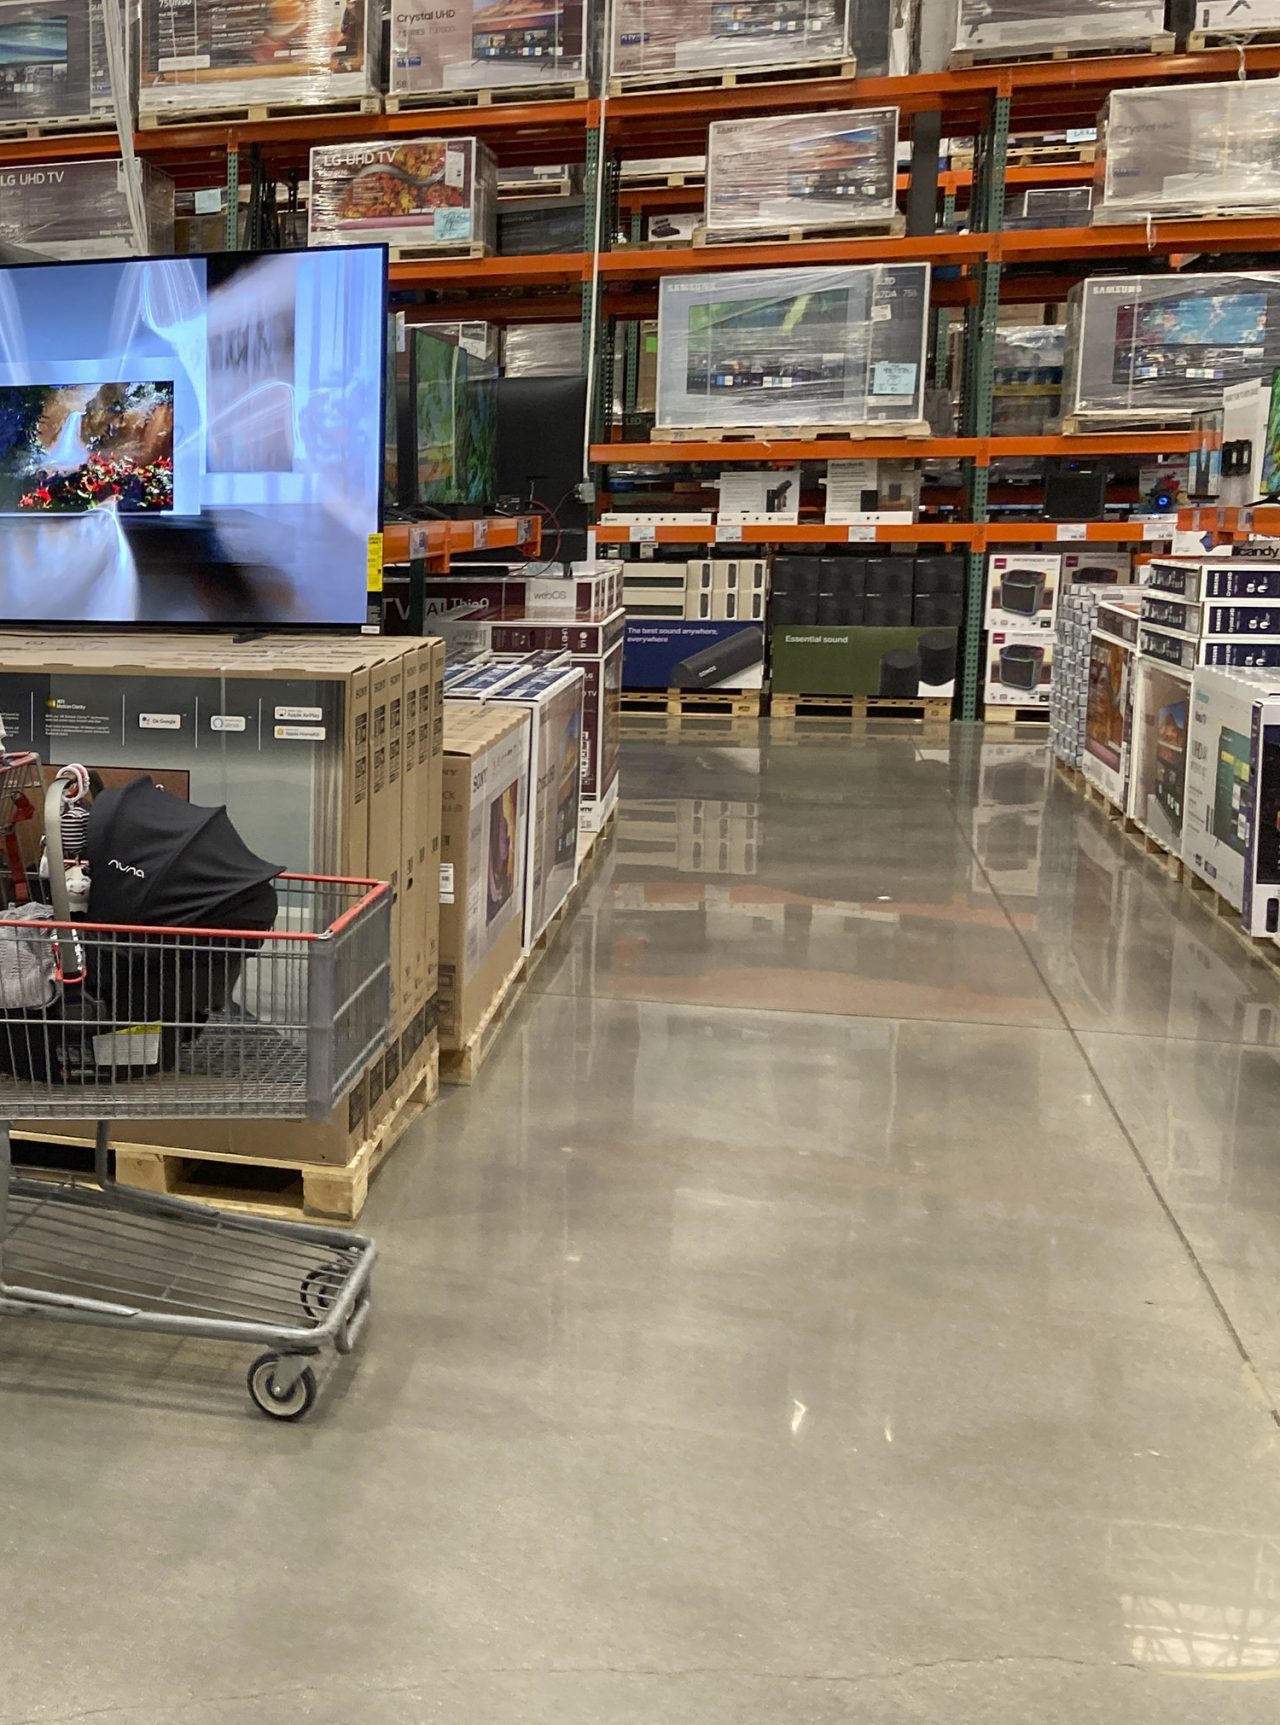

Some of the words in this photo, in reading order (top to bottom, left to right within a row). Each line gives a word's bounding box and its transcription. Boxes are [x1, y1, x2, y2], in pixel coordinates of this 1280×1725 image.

[397, 11, 434, 24] Crystal
[435, 9, 456, 19] UHD
[324, 154, 343, 167] LG
[346, 151, 375, 166] UHD
[377, 147, 401, 163] TV
[0, 174, 16, 187] LG
[19, 172, 46, 186] UHD
[47, 170, 65, 183] TV
[1092, 285, 1143, 295] SAMSUNG
[533, 590, 567, 600] webOS
[383, 598, 411, 621] TV
[627, 635, 669, 643] everywhere
[628, 627, 641, 635] The
[642, 627, 658, 635] best
[659, 627, 681, 636] sound
[682, 628, 718, 638] anywhere,
[785, 634, 821, 644] Essential
[823, 634, 849, 644] sound
[698, 665, 718, 679] SONOS
[108, 859, 145, 879] nuna
